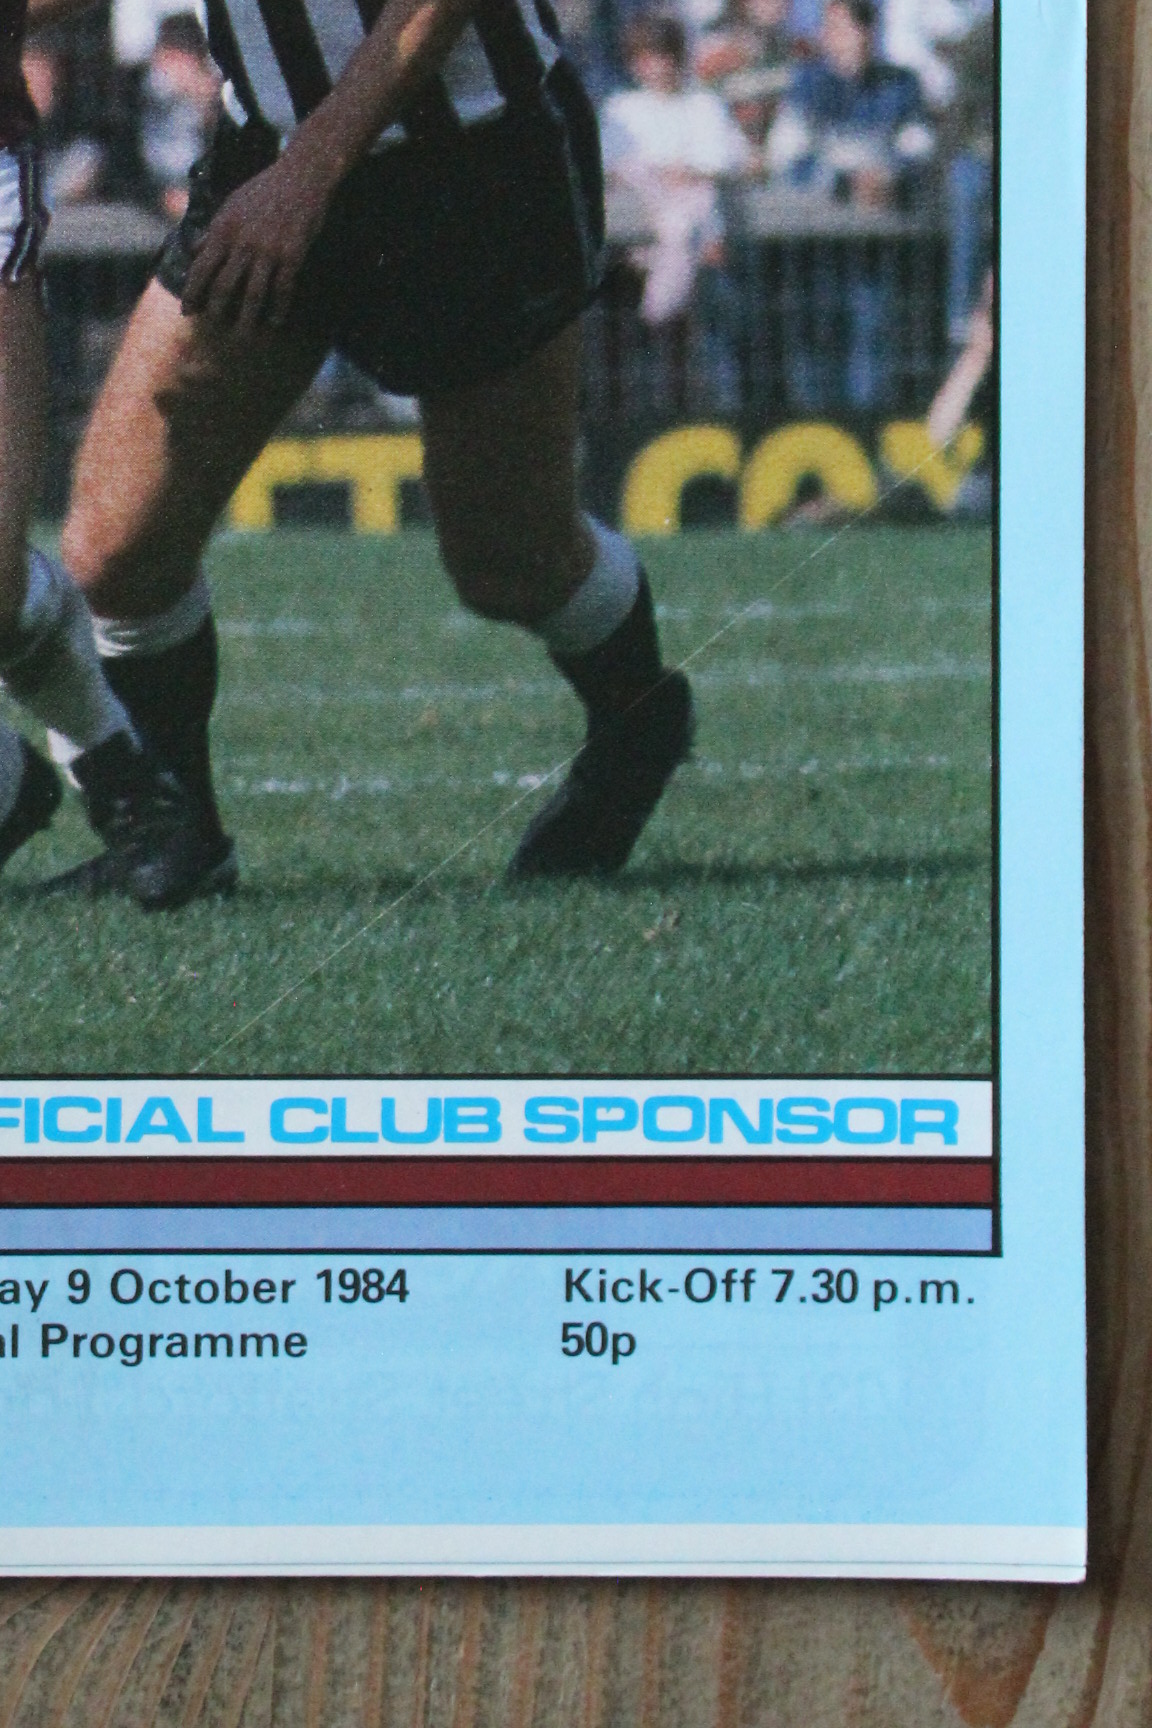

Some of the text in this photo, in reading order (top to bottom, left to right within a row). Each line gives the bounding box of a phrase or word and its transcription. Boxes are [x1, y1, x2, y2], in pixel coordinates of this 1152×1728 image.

[269, 1095, 503, 1145] CLUB
[523, 1094, 960, 1146] SPONSOR
[67, 1268, 91, 1305] 9
[110, 1268, 296, 1305] October
[316, 1267, 410, 1304] 1984
[565, 1267, 975, 1312] Kick-Off 7.30 p.m.
[41, 1323, 308, 1368] Programme
[561, 1321, 637, 1366] 50p
